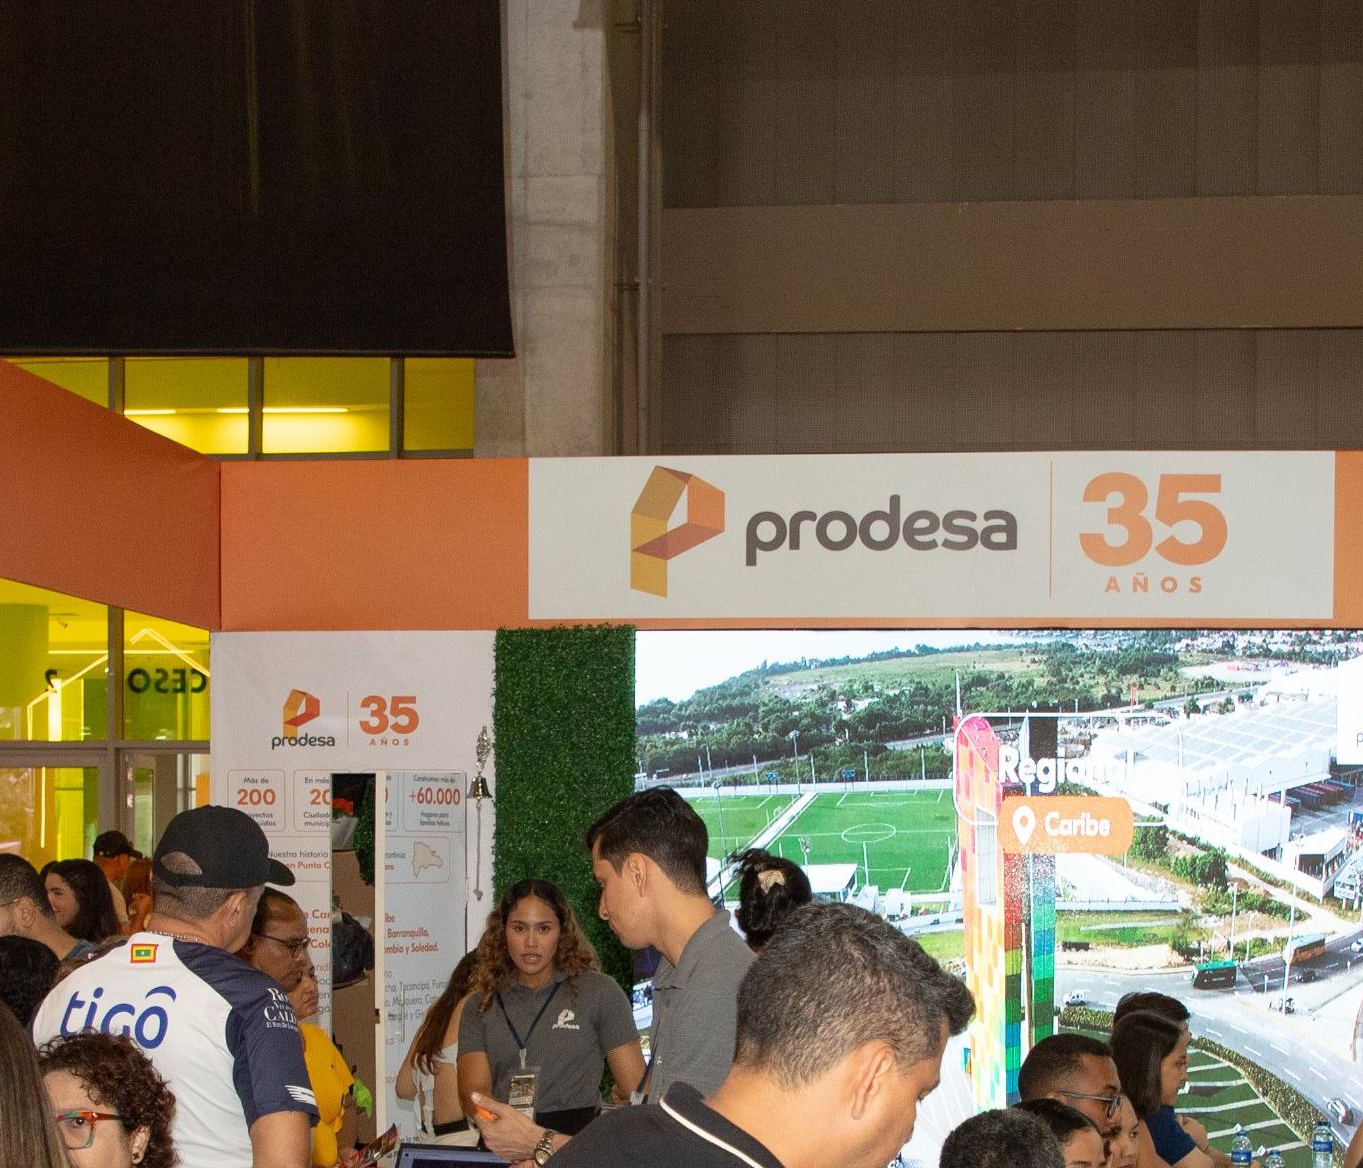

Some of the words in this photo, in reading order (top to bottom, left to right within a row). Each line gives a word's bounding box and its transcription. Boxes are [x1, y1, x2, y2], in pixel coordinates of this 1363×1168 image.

[745, 495, 1018, 567] prodesa
[1078, 472, 1228, 567] 35
[1103, 572, 1203, 594] AÑOS
[271, 732, 336, 750] prodesa
[358, 695, 419, 736] 35
[369, 736, 410, 746] AÑOS
[243, 776, 258, 784] Más
[260, 776, 269, 784] de
[315, 776, 329, 784] más
[236, 788, 277, 806] 200
[409, 786, 461, 806] +60.000
[303, 811, 331, 820] Ciudad
[304, 821, 330, 831] municip
[1044, 811, 1111, 837] Caribe
[299, 850, 329, 858] historia
[297, 861, 322, 870] Punta
[387, 927, 430, 940] Barranquilla,
